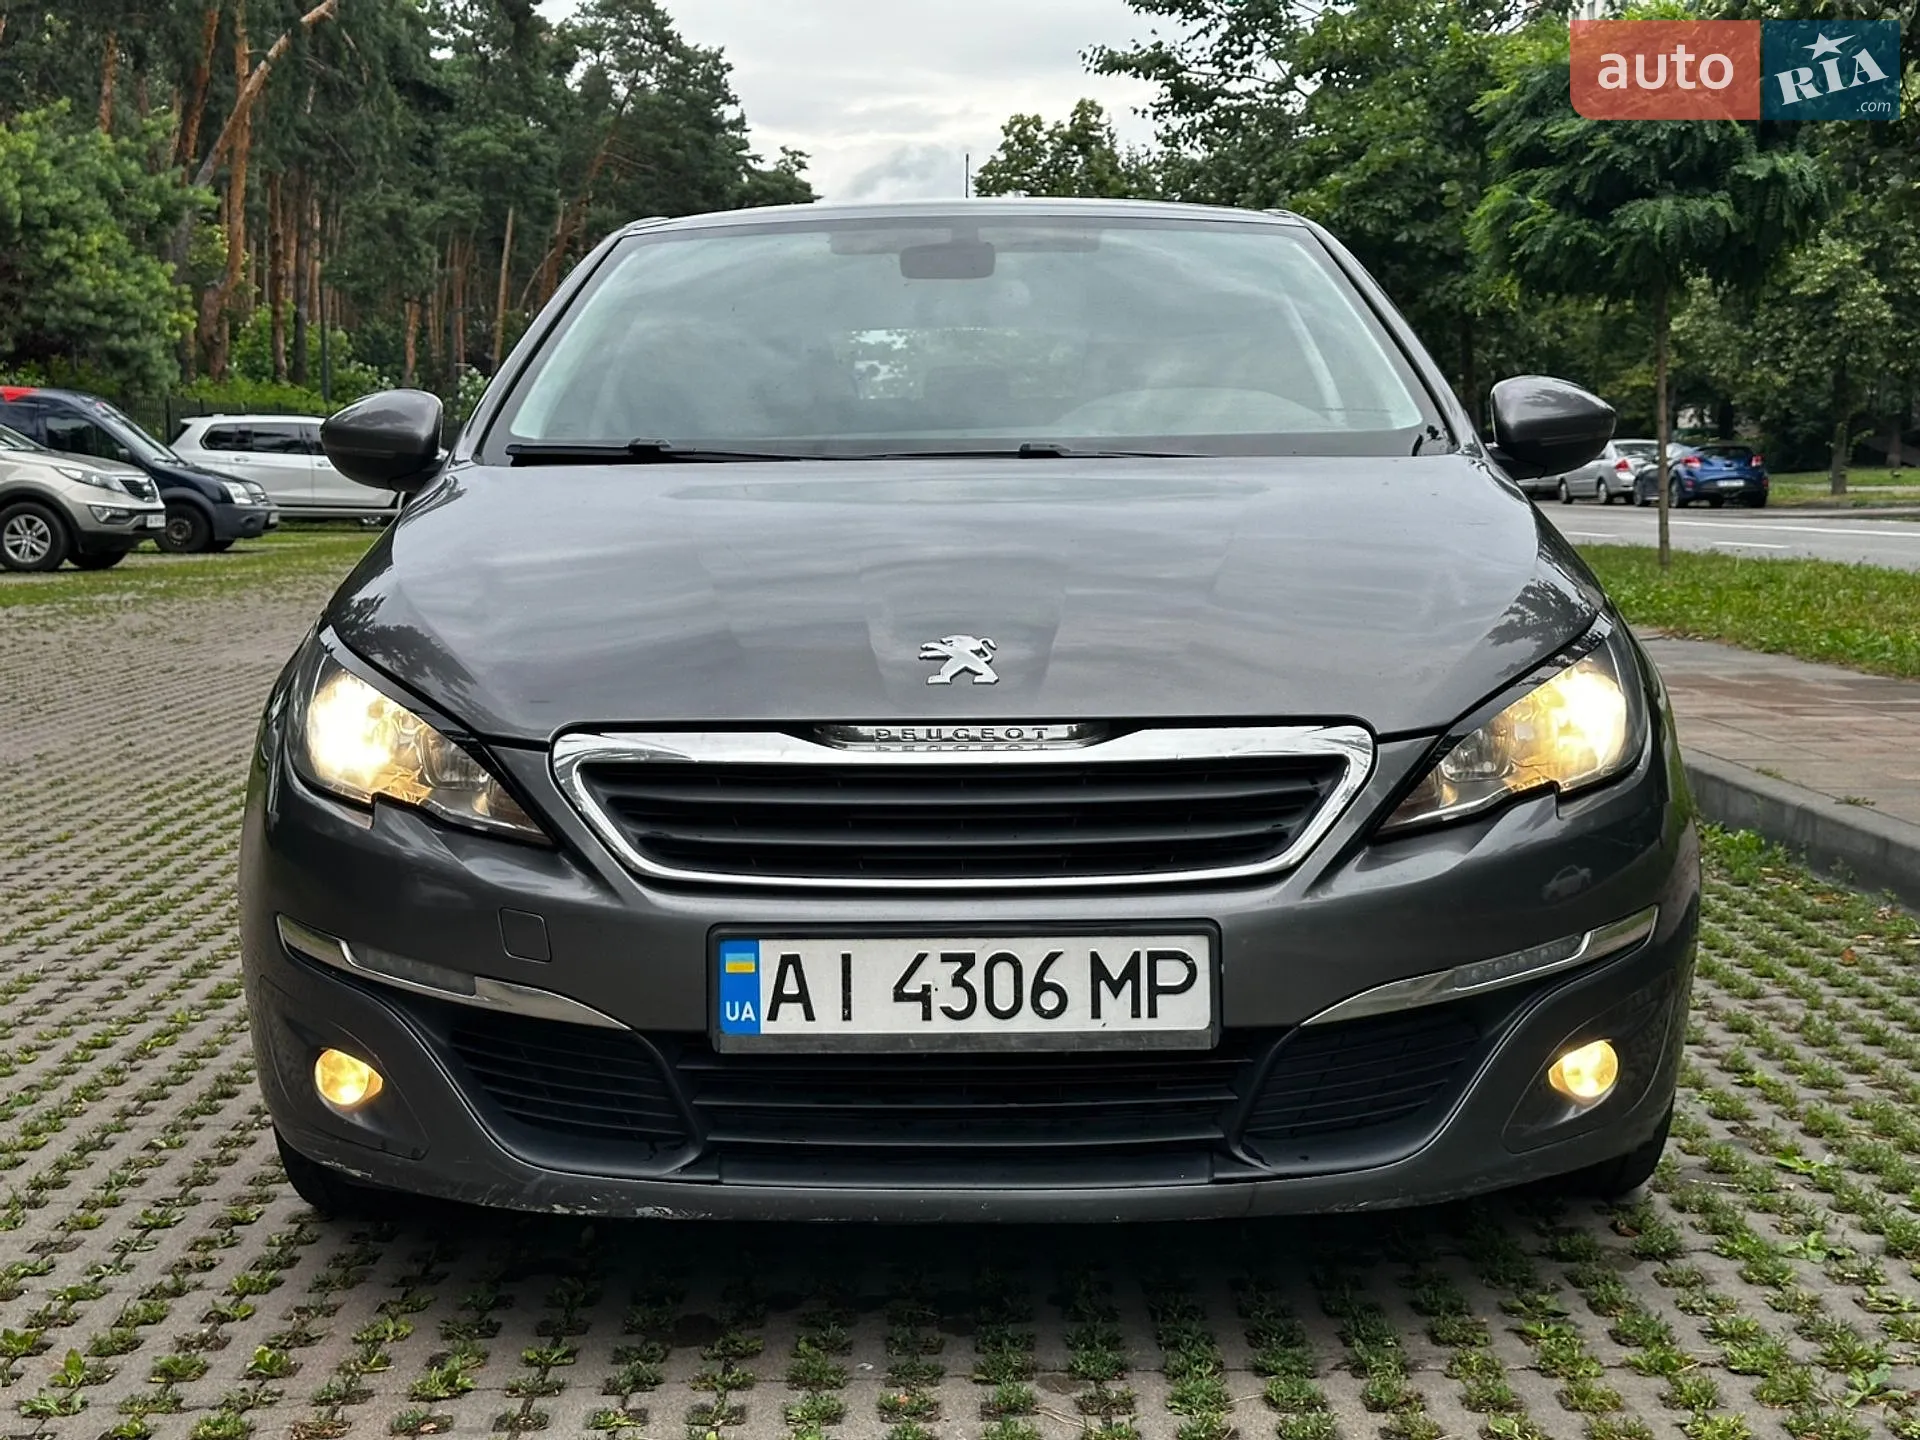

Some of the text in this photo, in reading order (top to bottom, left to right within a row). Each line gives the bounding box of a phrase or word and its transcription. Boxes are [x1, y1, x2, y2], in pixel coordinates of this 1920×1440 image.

[875, 727, 1049, 742] PEUGEOT
[766, 949, 1198, 1022] AI 4306 MP
[725, 1000, 756, 1021] UA
